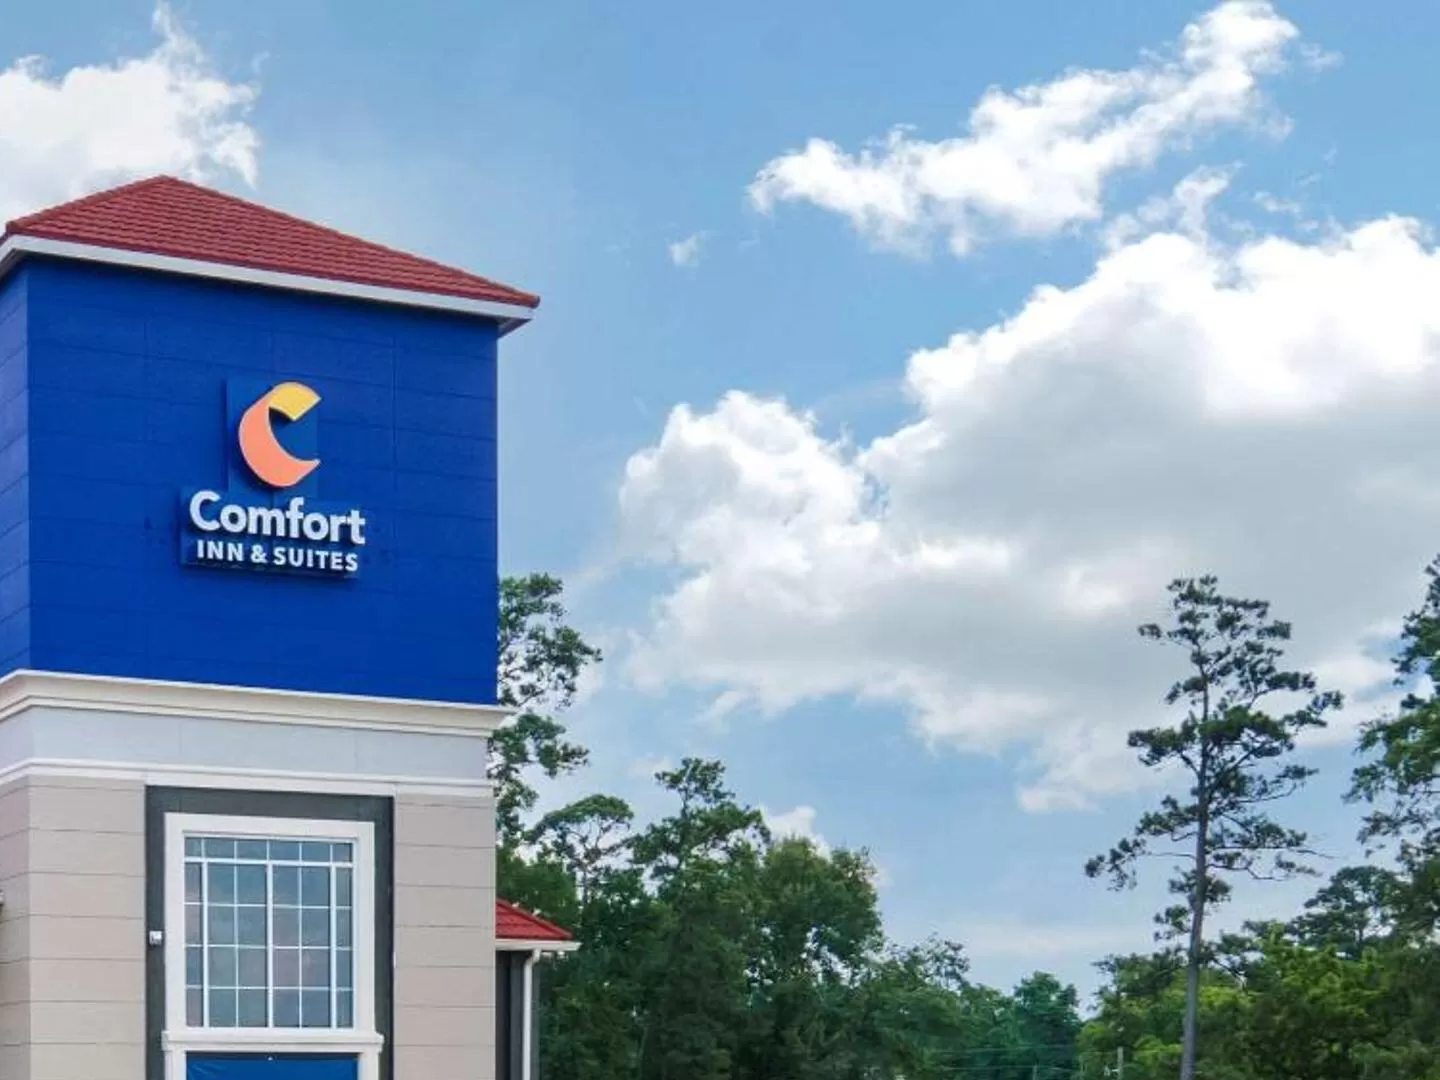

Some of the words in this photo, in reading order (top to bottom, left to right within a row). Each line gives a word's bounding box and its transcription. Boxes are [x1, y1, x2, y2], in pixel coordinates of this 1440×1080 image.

[189, 490, 366, 545] Comfort
[197, 540, 245, 562] INN
[250, 544, 268, 564] &
[272, 546, 359, 572] SUITES
